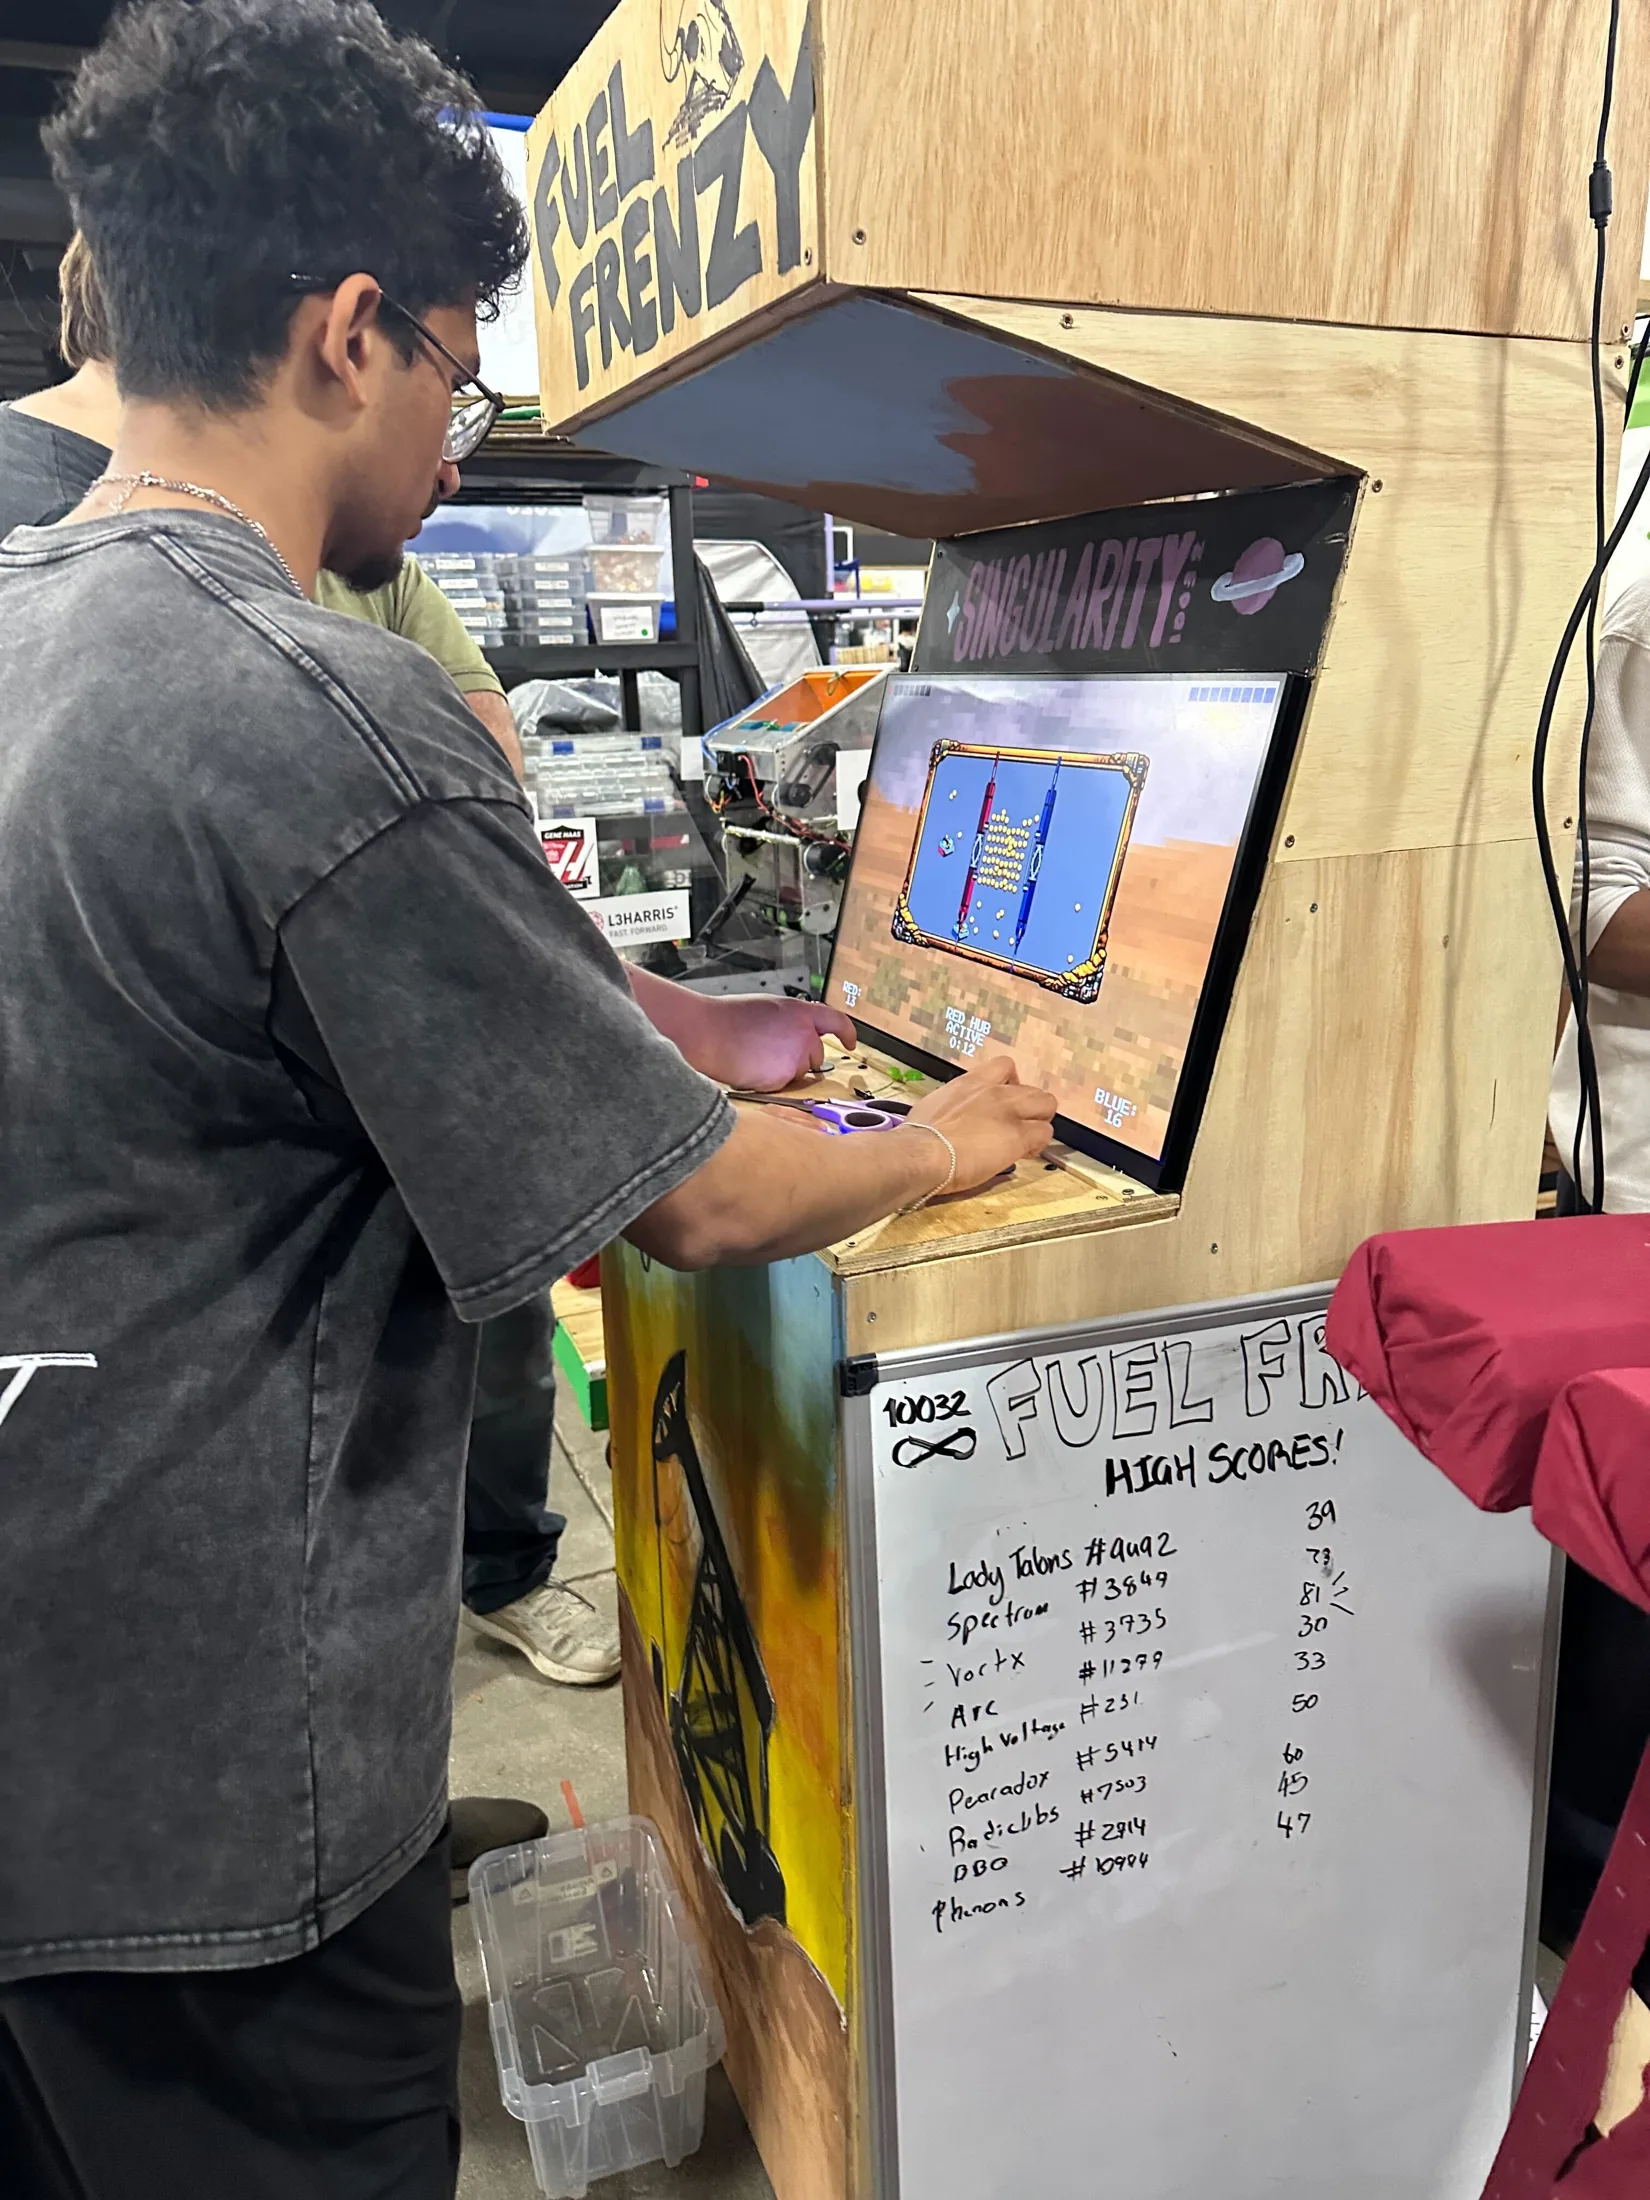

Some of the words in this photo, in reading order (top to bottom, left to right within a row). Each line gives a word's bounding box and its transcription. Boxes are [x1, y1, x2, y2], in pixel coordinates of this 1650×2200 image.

[534, 60, 655, 311] FUEL
[569, 0, 816, 391] FRENZY
[953, 530, 1196, 662] SINGULARITY
[843, 980, 862, 997] RED:
[945, 1006, 965, 1024] RED
[970, 1016, 992, 1036] HUB
[945, 1020, 986, 1047] ACTIVE
[949, 1036, 976, 1057] 0:12
[1094, 1087, 1137, 1117] BLUE:
[1104, 1109, 1123, 1128] 16
[986, 1340, 1213, 1461] FUEL
[1240, 1313, 1370, 1417] FR
[883, 1390, 972, 1428] 10032
[1105, 1446, 1196, 1497] HIGH
[1208, 1428, 1345, 1484] SCORES!
[948, 1560, 1005, 1605] Lady
[1009, 1545, 1073, 1580] Talons
[1305, 1500, 1336, 1530] 39
[1079, 1607, 1167, 1644] #3735
[1300, 1582, 1320, 1605] 81
[1298, 1615, 1328, 1637] 30
[945, 1736, 994, 1773] High
[1294, 1651, 1326, 1670] 33
[1292, 1694, 1318, 1713] 50
[1282, 1743, 1304, 1764] 60
[1277, 1811, 1311, 1838] 47
